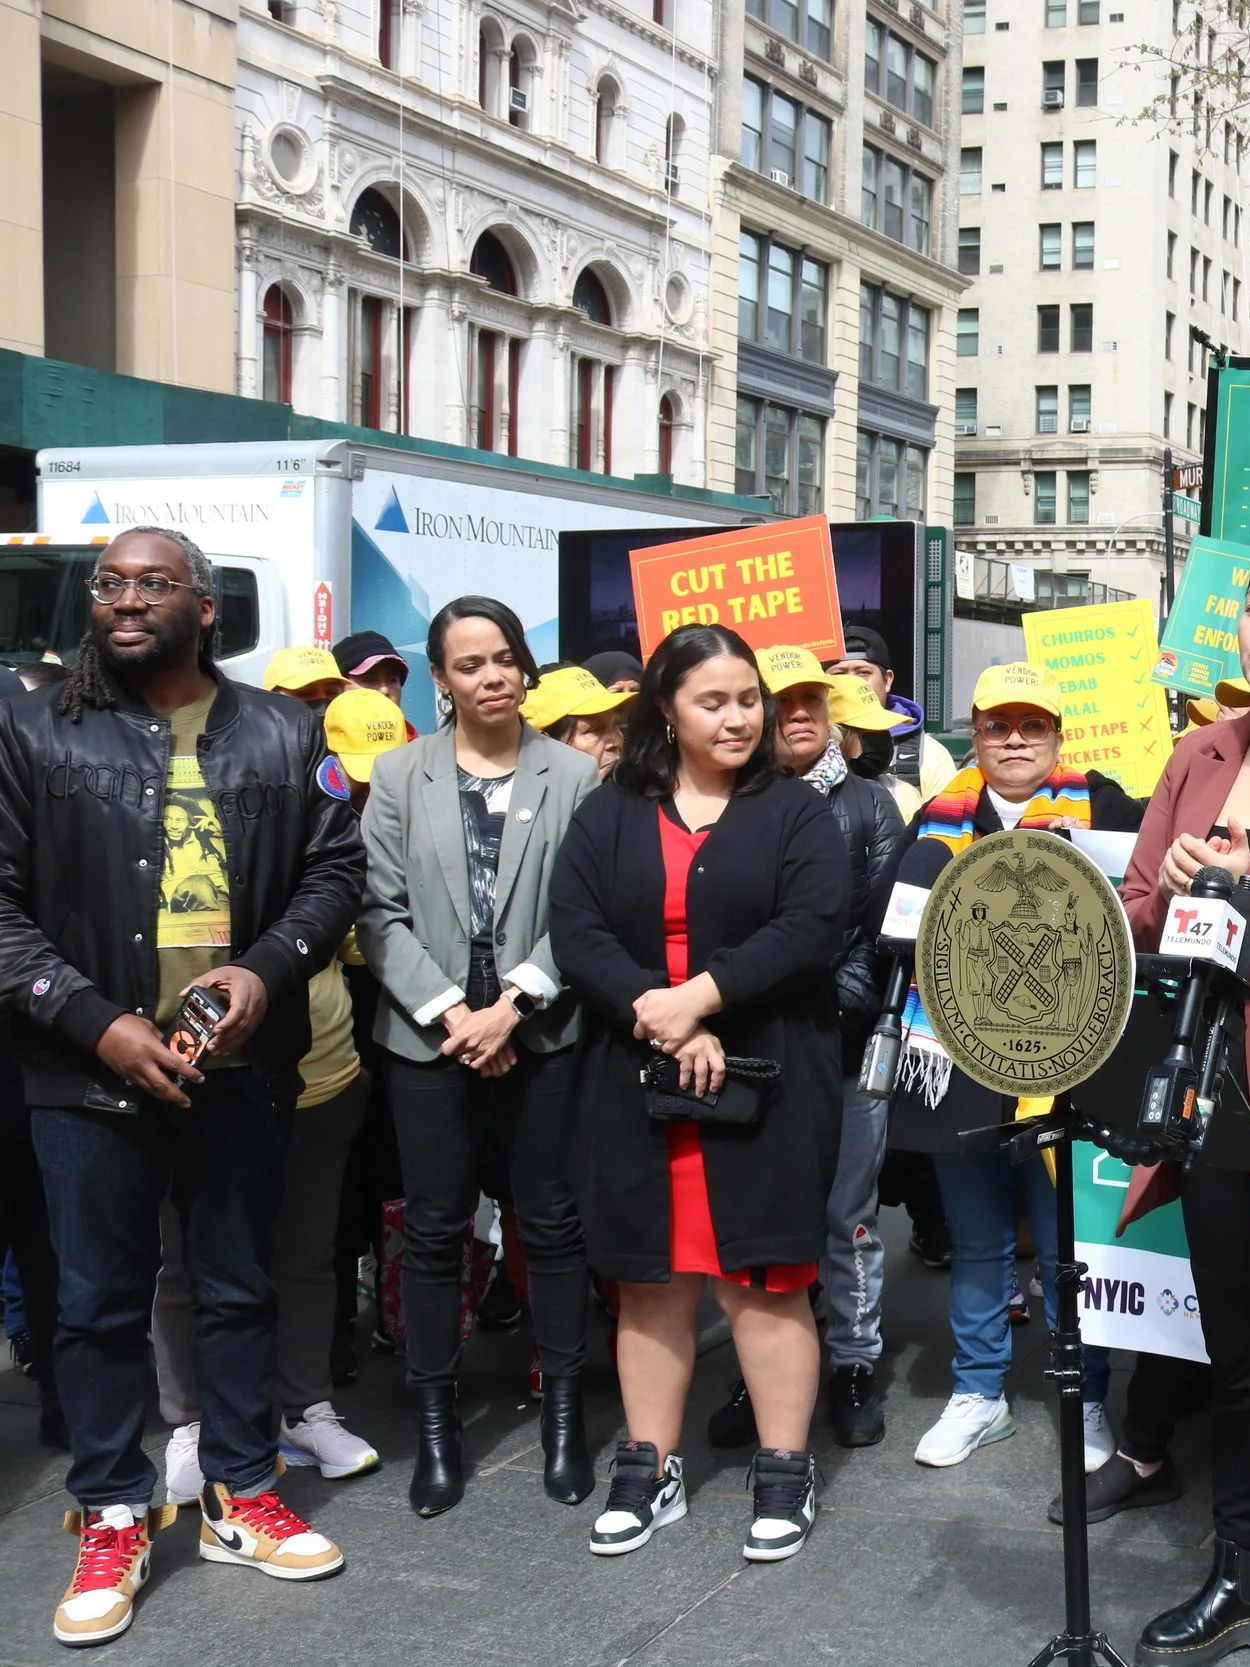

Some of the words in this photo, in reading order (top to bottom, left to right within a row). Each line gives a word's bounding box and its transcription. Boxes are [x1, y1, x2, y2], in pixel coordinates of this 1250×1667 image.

[48, 461, 81, 473] 11684
[1179, 466, 1203, 488] MUR
[115, 503, 159, 524] IRON
[166, 502, 271, 524] MOUNTAIN
[414, 507, 463, 539] IRON
[670, 563, 727, 597] CUT
[736, 551, 795, 585] THE
[727, 587, 803, 624] TAPE
[1205, 594, 1240, 618] FAIR
[1042, 626, 1116, 647] CHURROS
[1045, 652, 1106, 670] MOMOS
[1059, 677, 1098, 694] EBAB
[1064, 702, 1100, 717] ALAL
[1065, 727, 1085, 741] ED
[1089, 721, 1128, 738] TAPE
[1059, 746, 1121, 765] TICKETS
[1190, 922, 1213, 936] 47
[1166, 935, 1212, 947] TELEMUNDO
[1008, 1039, 1041, 1054] 1625
[1084, 1277, 1145, 1317] NYIC
